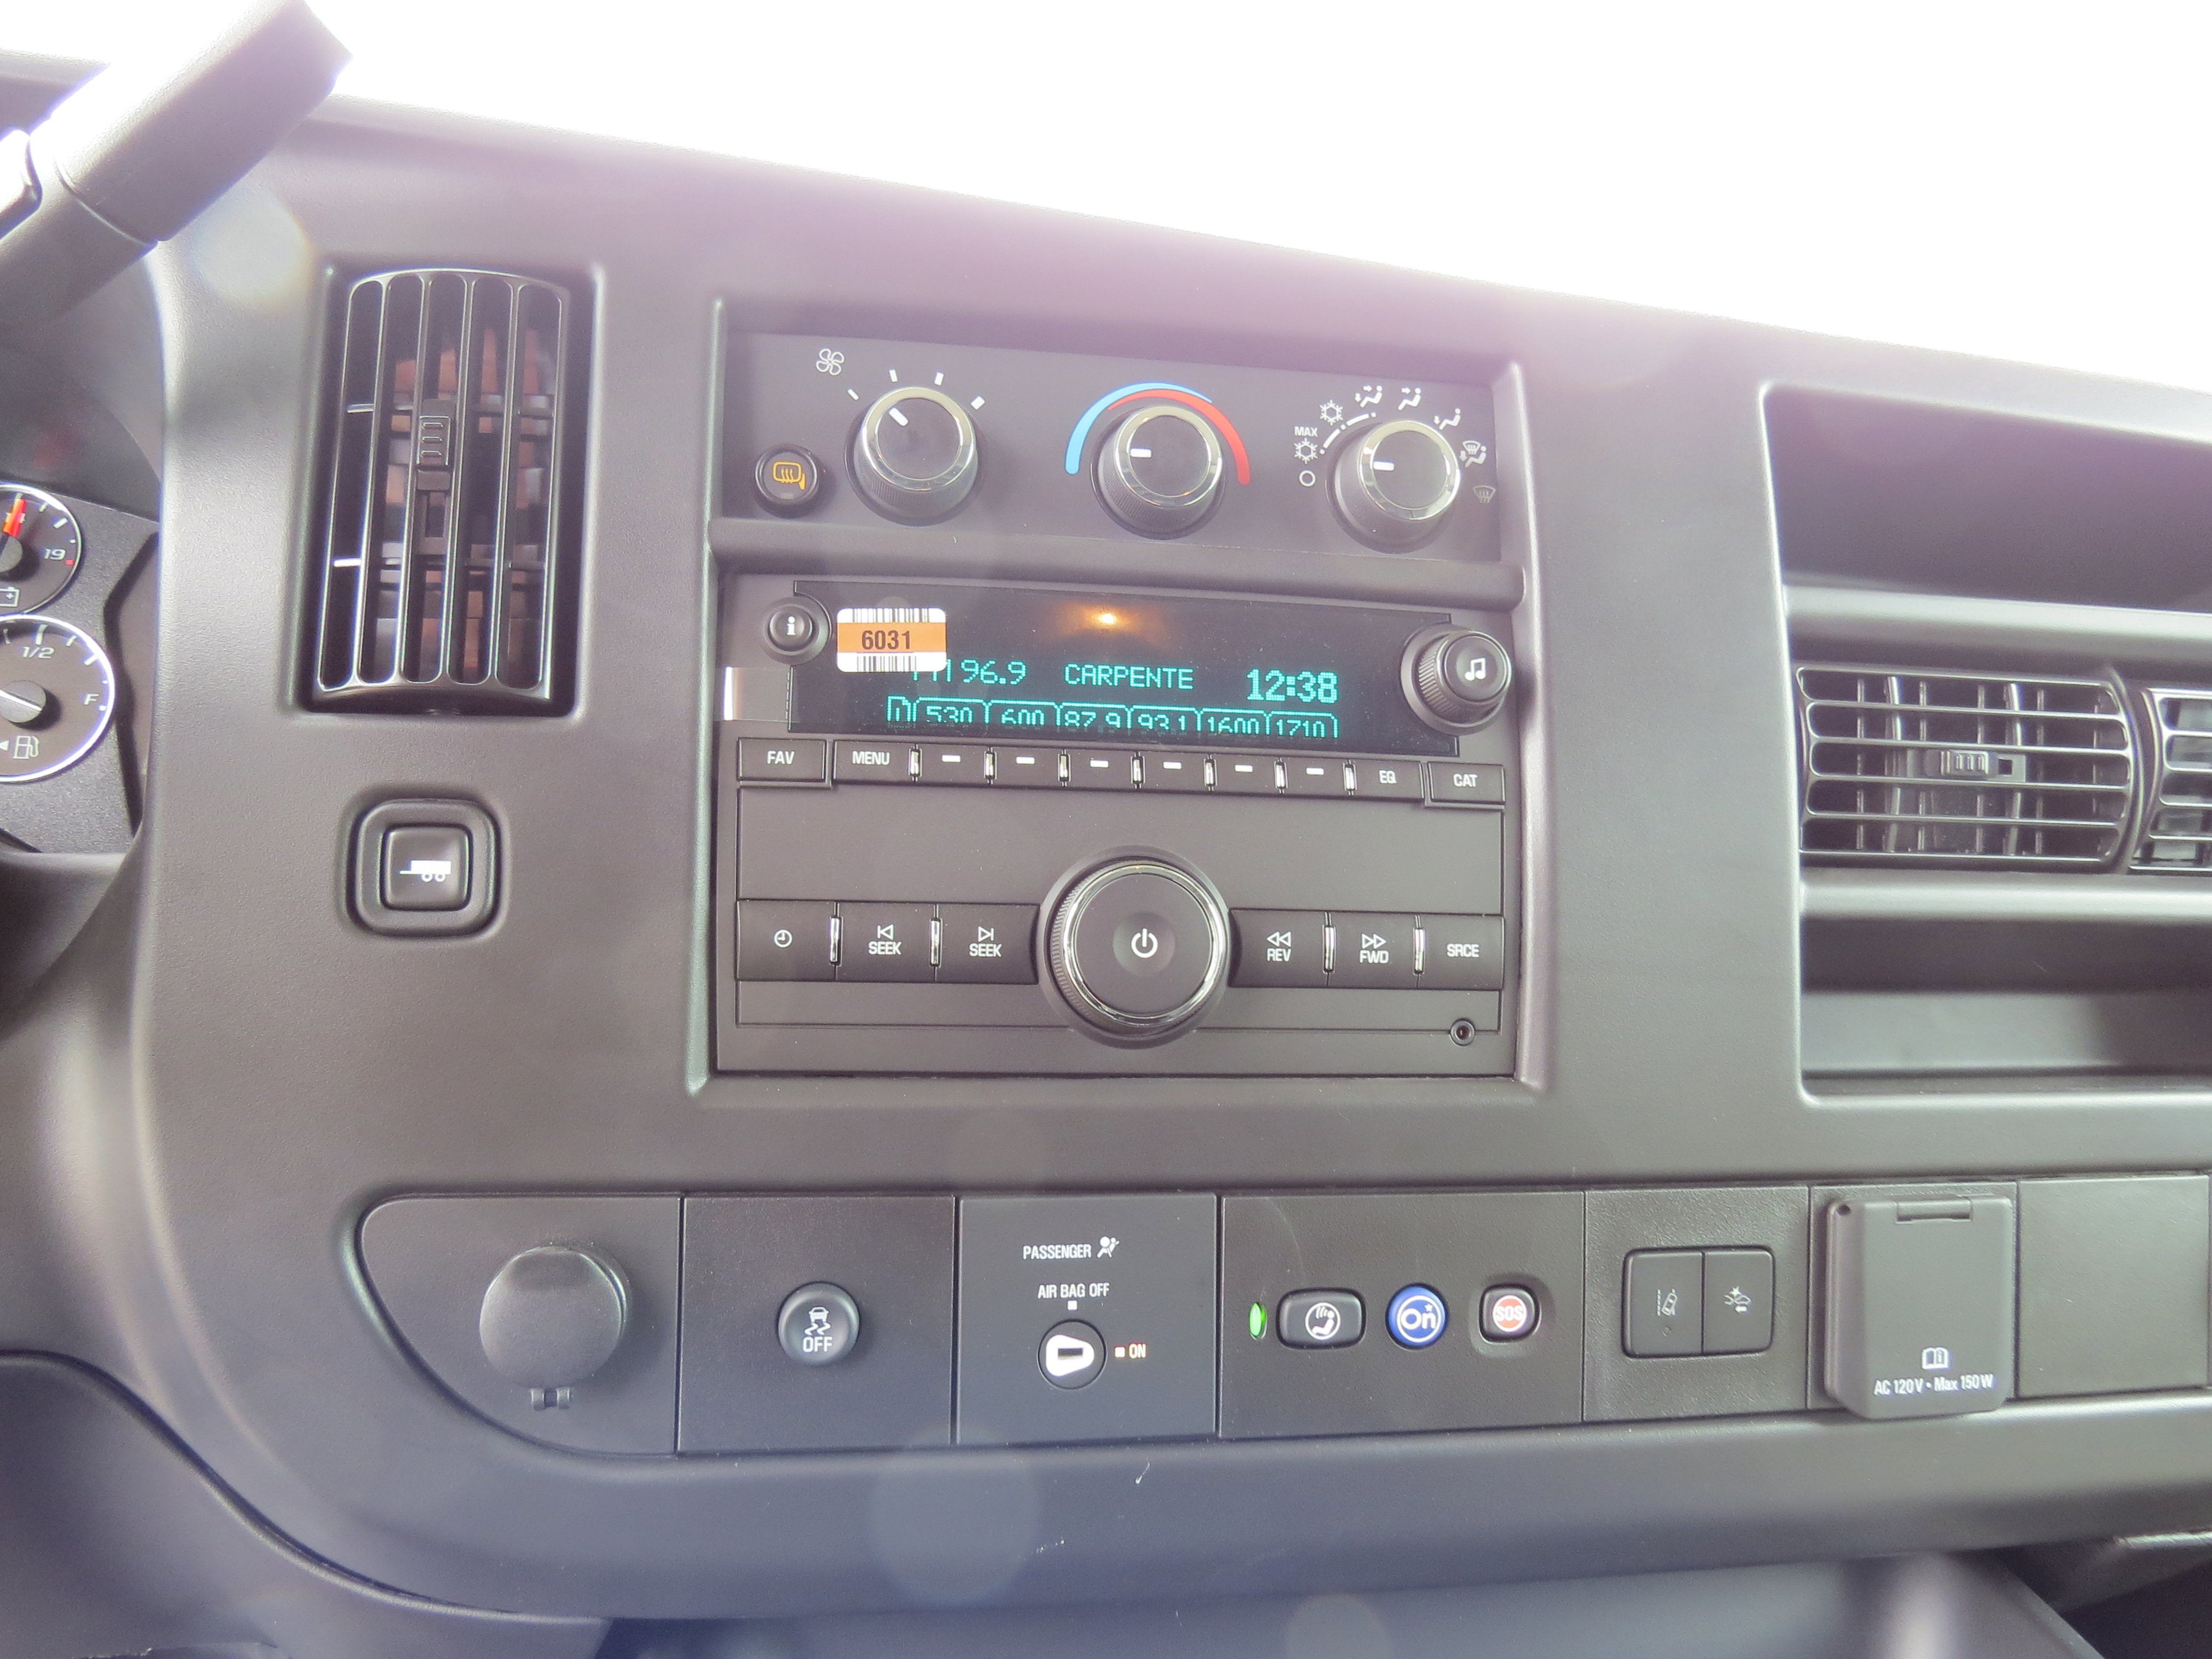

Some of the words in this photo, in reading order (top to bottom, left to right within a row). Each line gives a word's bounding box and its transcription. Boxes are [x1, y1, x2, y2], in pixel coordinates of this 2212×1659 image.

[1295, 426, 1318, 437] MAX
[44, 548, 66, 560] 19
[862, 630, 910, 650] 6031
[22, 646, 54, 658] 1/2
[961, 659, 1026, 685] 96.9
[1065, 663, 1194, 690] CARPENTE
[1246, 669, 1338, 703] 12:38
[84, 693, 99, 705] F
[1064, 711, 1121, 728] 879
[767, 750, 795, 765] FAV
[852, 751, 890, 766] MENU
[1379, 770, 1397, 784] EQ
[1453, 774, 1478, 787] CAT
[869, 941, 902, 955] SEEK
[969, 943, 1002, 957] SEEK
[1267, 948, 1292, 962] REV
[1447, 943, 1480, 958] SRCE
[1359, 950, 1389, 963] FWD
[1023, 1244, 1092, 1260] PASSENGER
[1037, 1284, 1057, 1299] AIR
[1060, 1284, 1085, 1297] BAG
[1089, 1282, 1110, 1297] OFF
[1495, 1306, 1523, 1321] SOS
[803, 1337, 833, 1353] OFF
[1129, 1343, 1146, 1359] ON
[1874, 1379, 1892, 1395] AC
[1934, 1376, 1958, 1391] Max
